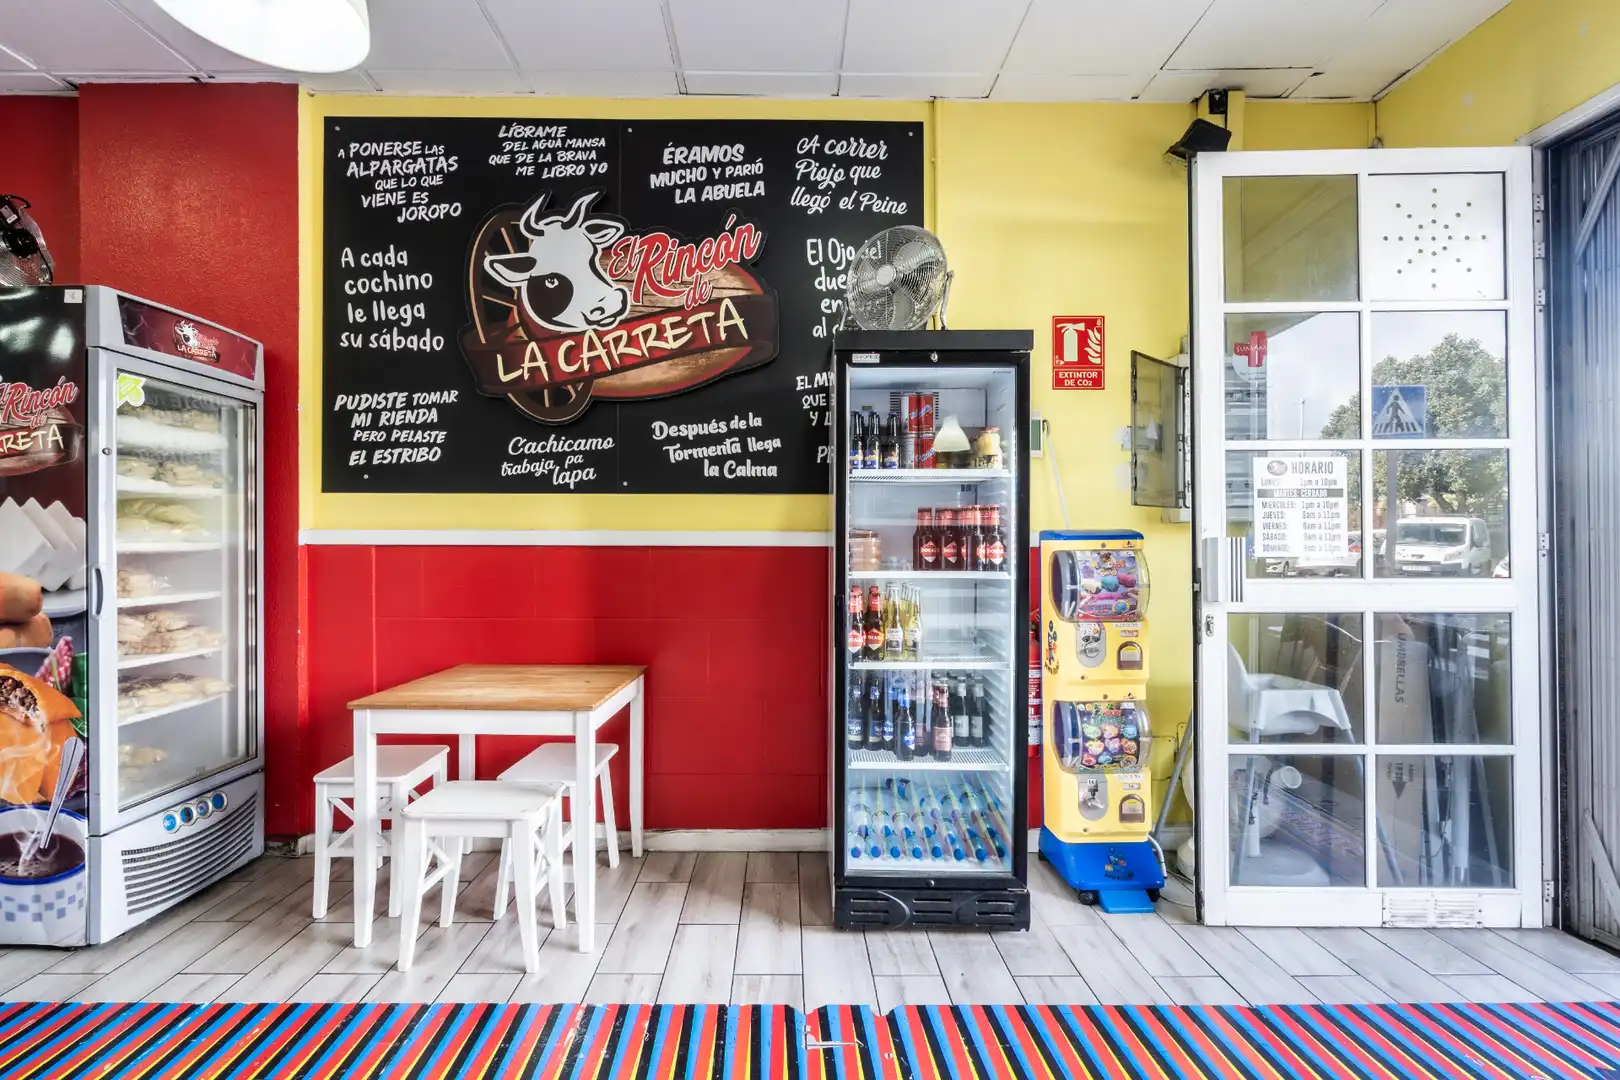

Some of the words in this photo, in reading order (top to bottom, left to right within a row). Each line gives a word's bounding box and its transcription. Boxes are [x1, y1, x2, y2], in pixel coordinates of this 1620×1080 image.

[498, 122, 567, 138] LÍBRAME
[337, 148, 345, 159] A
[349, 141, 422, 158] PONERSE
[424, 145, 445, 155] LAS
[503, 140, 529, 153] DEL
[531, 138, 562, 150] AGUA
[564, 137, 606, 148] MANSA
[662, 141, 745, 165] ÉRAMOS
[796, 134, 821, 155] A
[823, 138, 888, 160] correr
[346, 156, 459, 178] ALPARGATAS
[488, 153, 511, 165] QUE
[515, 152, 535, 164] DE
[538, 151, 552, 163] LA
[556, 150, 597, 162] BRAVA
[515, 165, 535, 176] ME
[541, 164, 585, 179] LIBRO
[589, 162, 609, 176] YO
[650, 166, 707, 189] MUCHO
[712, 167, 724, 180] Y
[725, 158, 764, 178] PARIÓ
[795, 158, 846, 189] Piojo
[849, 162, 882, 186] que
[375, 177, 398, 191] QUE
[401, 175, 417, 188] LO
[420, 174, 444, 188] QUE
[675, 187, 696, 204] LA
[701, 180, 765, 202] ABUELA
[361, 191, 406, 208] VIENE
[412, 191, 429, 204] ES
[790, 186, 832, 215] llegó
[838, 192, 856, 211] el
[859, 192, 908, 215] Peine
[397, 202, 462, 224] JOROPO
[340, 247, 355, 268] A
[360, 244, 408, 268] cada
[607, 235, 640, 281] El
[631, 214, 762, 304] Rincón
[806, 238, 823, 266] El
[827, 237, 856, 271] Ojo
[344, 269, 433, 295] cochino
[684, 273, 714, 311] de
[347, 302, 367, 323] le
[372, 300, 425, 327] llega
[812, 316, 827, 338] al
[339, 331, 362, 349] su
[369, 327, 445, 353] sábado
[496, 341, 549, 383] LA
[557, 297, 749, 373] CARRETA
[795, 375, 812, 391] EL
[1058, 371, 1098, 379] EXTINTOR
[1, 375, 79, 424] Rincón
[334, 392, 409, 411] PUDISTE
[412, 389, 459, 406] TOMAR
[802, 393, 827, 409] QUE
[29, 409, 48, 430] de
[351, 412, 372, 429] MI
[379, 408, 438, 427] RIENDA
[651, 418, 727, 441] Después
[730, 415, 747, 430] de
[748, 412, 763, 427] la
[809, 411, 819, 426] Y
[0, 423, 65, 454] RETA
[353, 430, 387, 443] PERO
[390, 429, 447, 444] PELASTE
[507, 434, 615, 456] Cachicamo
[349, 450, 367, 466] EL
[372, 446, 442, 465] ESTRIBO
[663, 436, 742, 463] Tormenta
[747, 435, 782, 452] llega
[501, 456, 555, 478] trabaja
[565, 453, 584, 468] pa
[553, 463, 597, 489] lapa
[704, 459, 720, 477] la
[723, 459, 778, 479] Calma
[1291, 461, 1334, 474] HORARIO
[1394, 633, 1407, 703] UMBRELLAS
